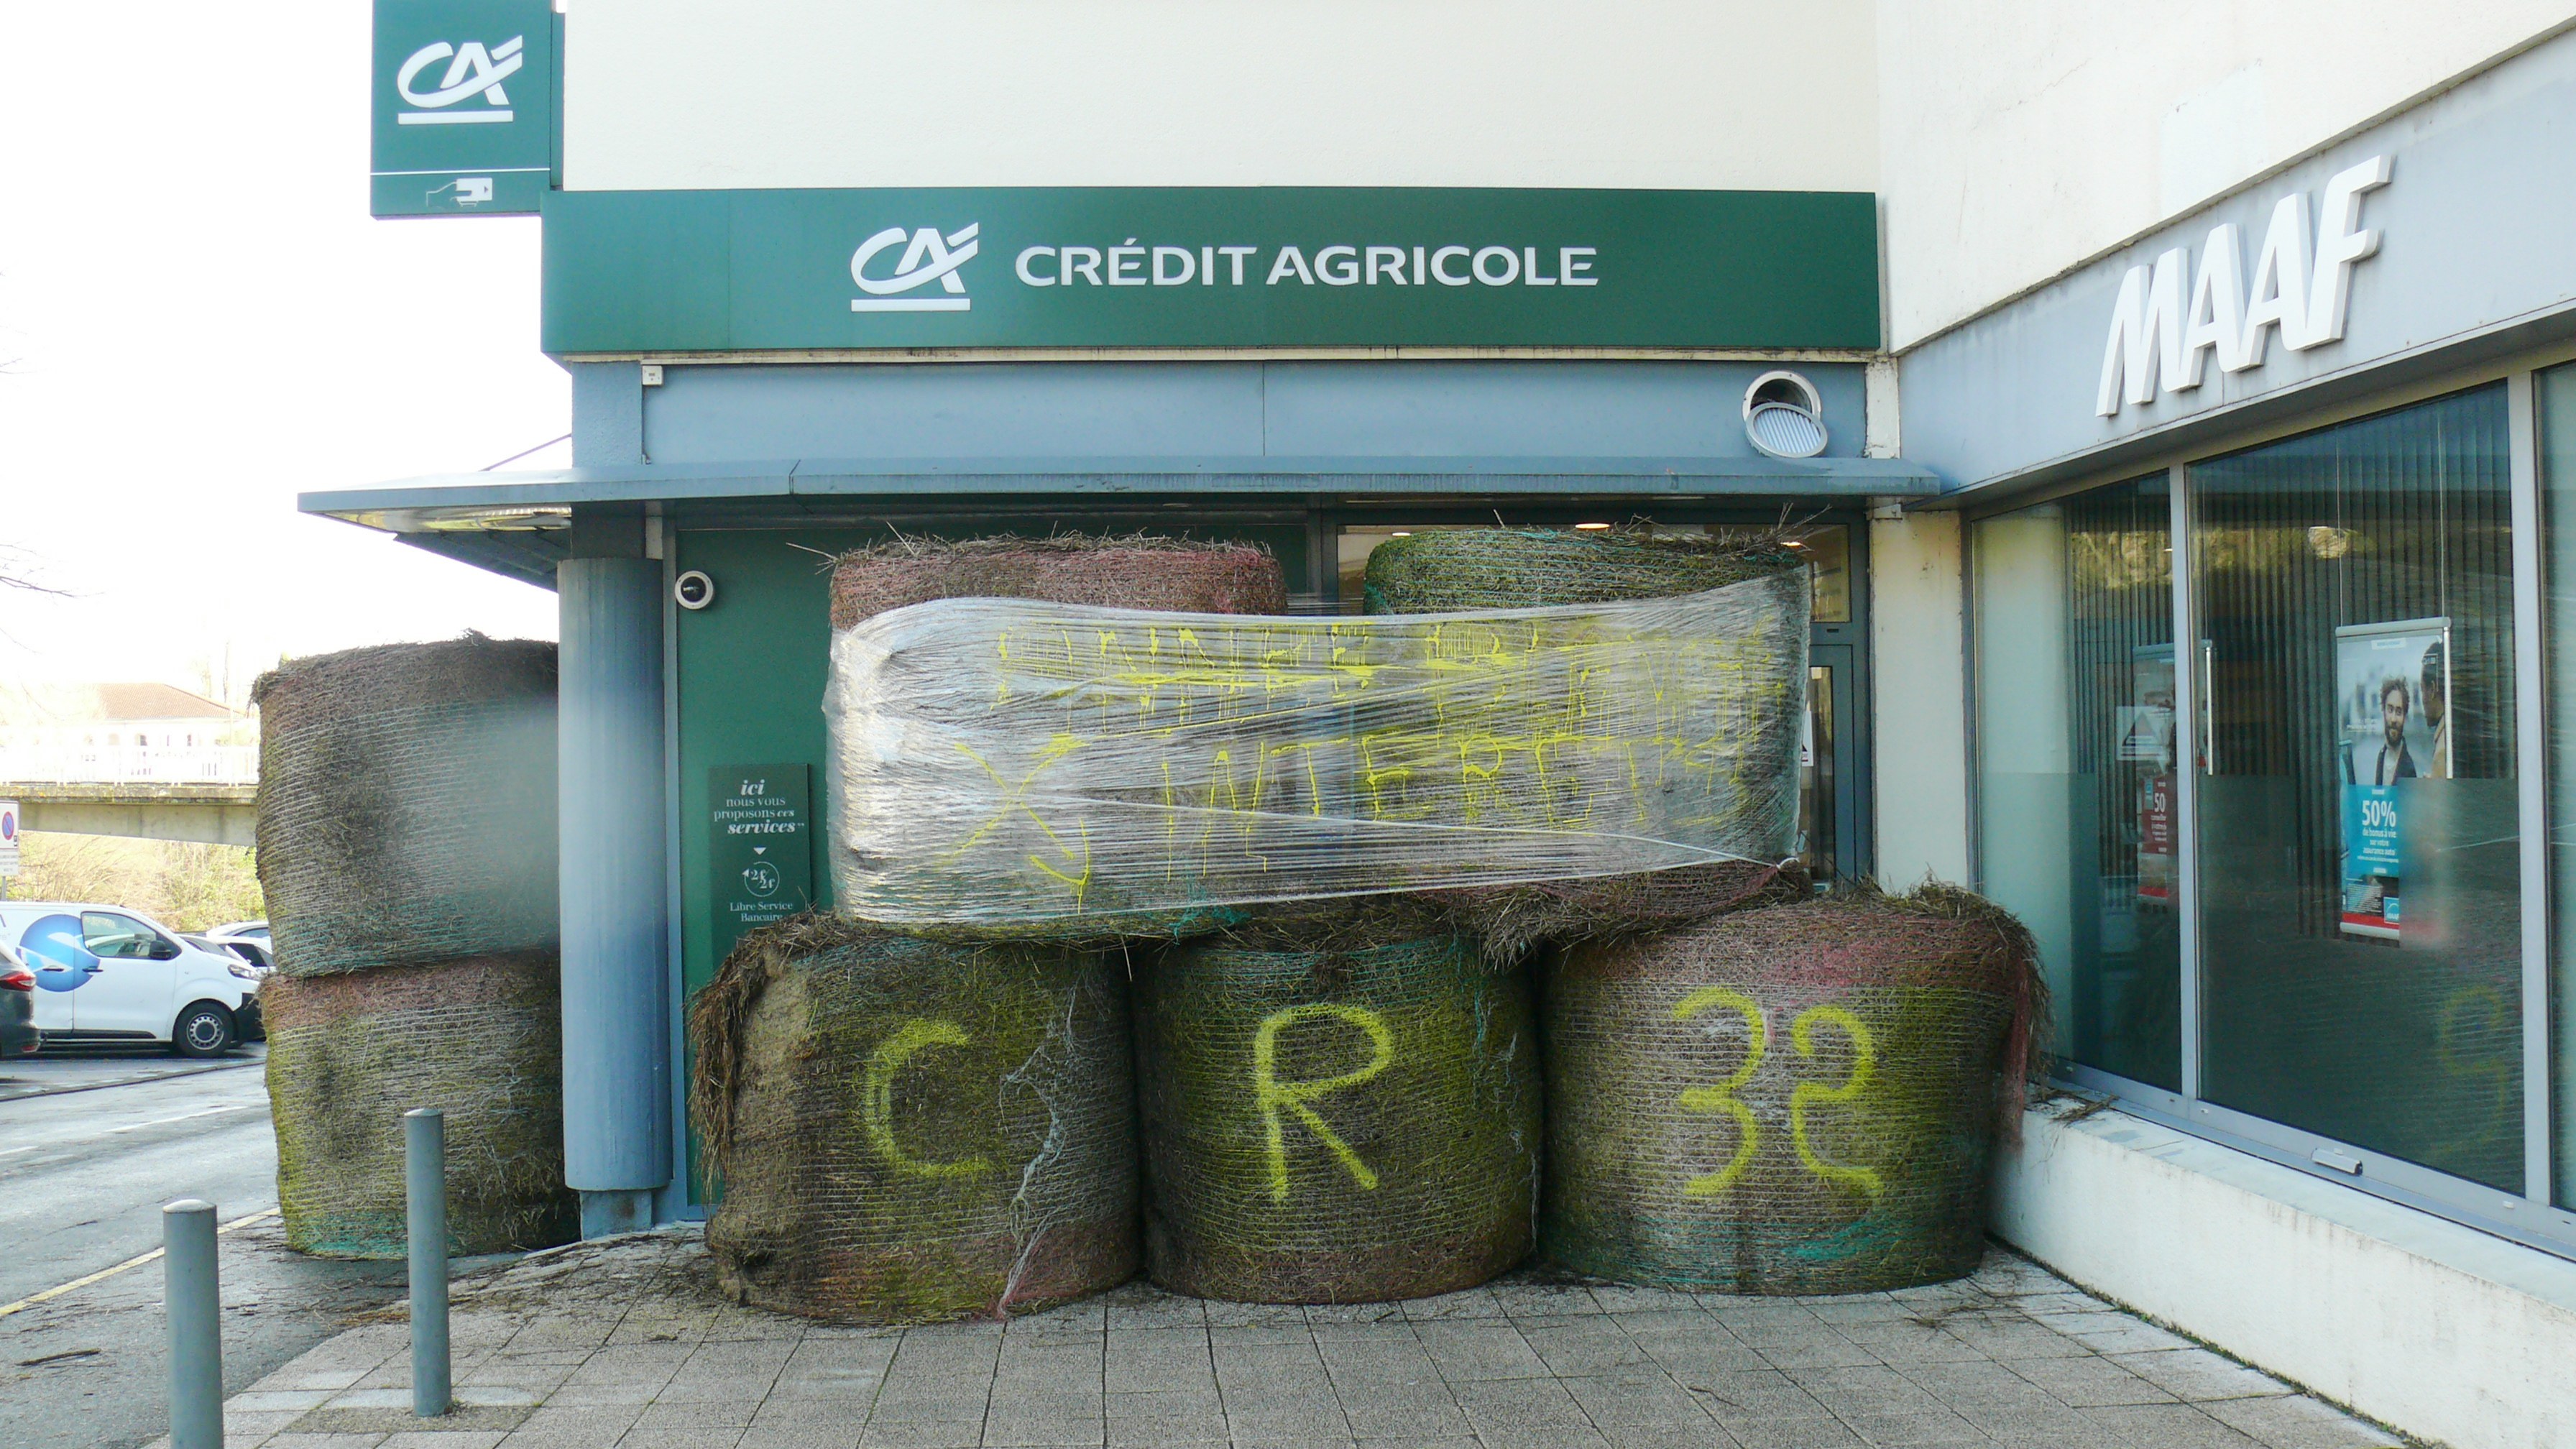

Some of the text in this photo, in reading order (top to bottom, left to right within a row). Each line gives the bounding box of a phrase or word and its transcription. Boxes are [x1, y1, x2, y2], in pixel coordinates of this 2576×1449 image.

[1015, 237, 1599, 287] CRÉDIT AGRICOLE
[2095, 153, 2396, 419] MAAF
[740, 778, 765, 796] ici
[726, 797, 786, 807] nous vous
[714, 809, 775, 822] proposons
[2362, 799, 2397, 828] 50%
[727, 819, 796, 834] services
[730, 901, 794, 911] Libre Service
[741, 913, 783, 922] Bancaire
[864, 987, 1885, 1202] C R 32
